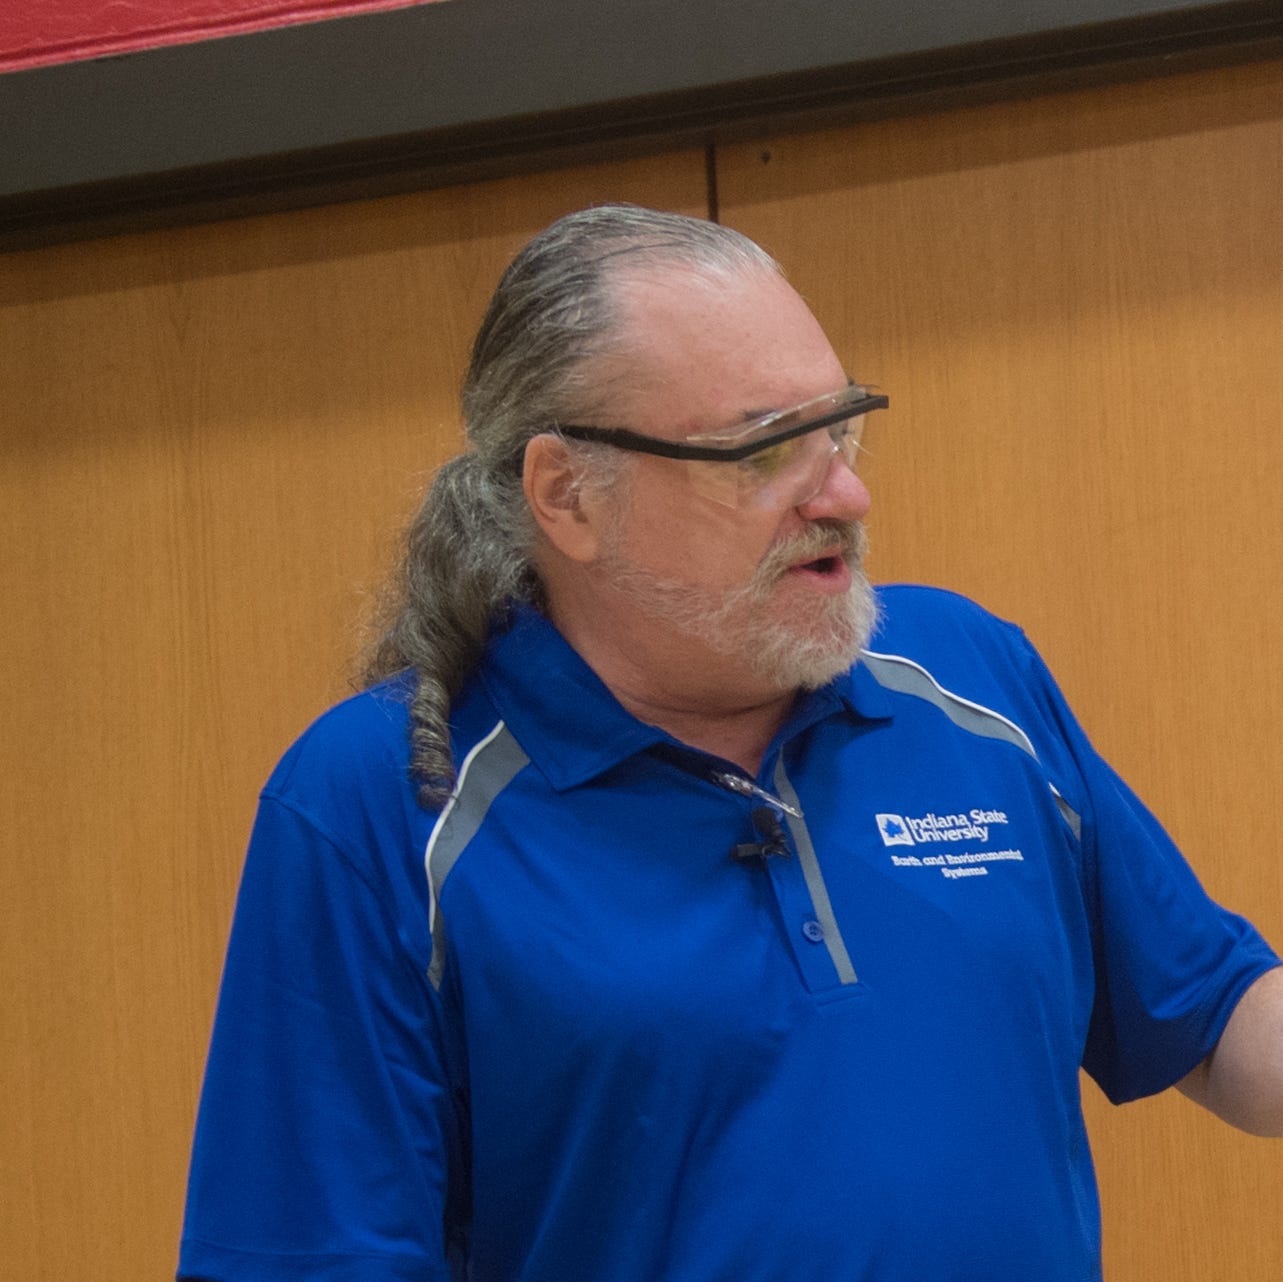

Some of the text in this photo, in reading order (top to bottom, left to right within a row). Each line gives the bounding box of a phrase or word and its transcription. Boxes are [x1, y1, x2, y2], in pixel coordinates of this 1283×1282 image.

[905, 809, 1008, 829] Indiana State
[914, 826, 988, 842] University
